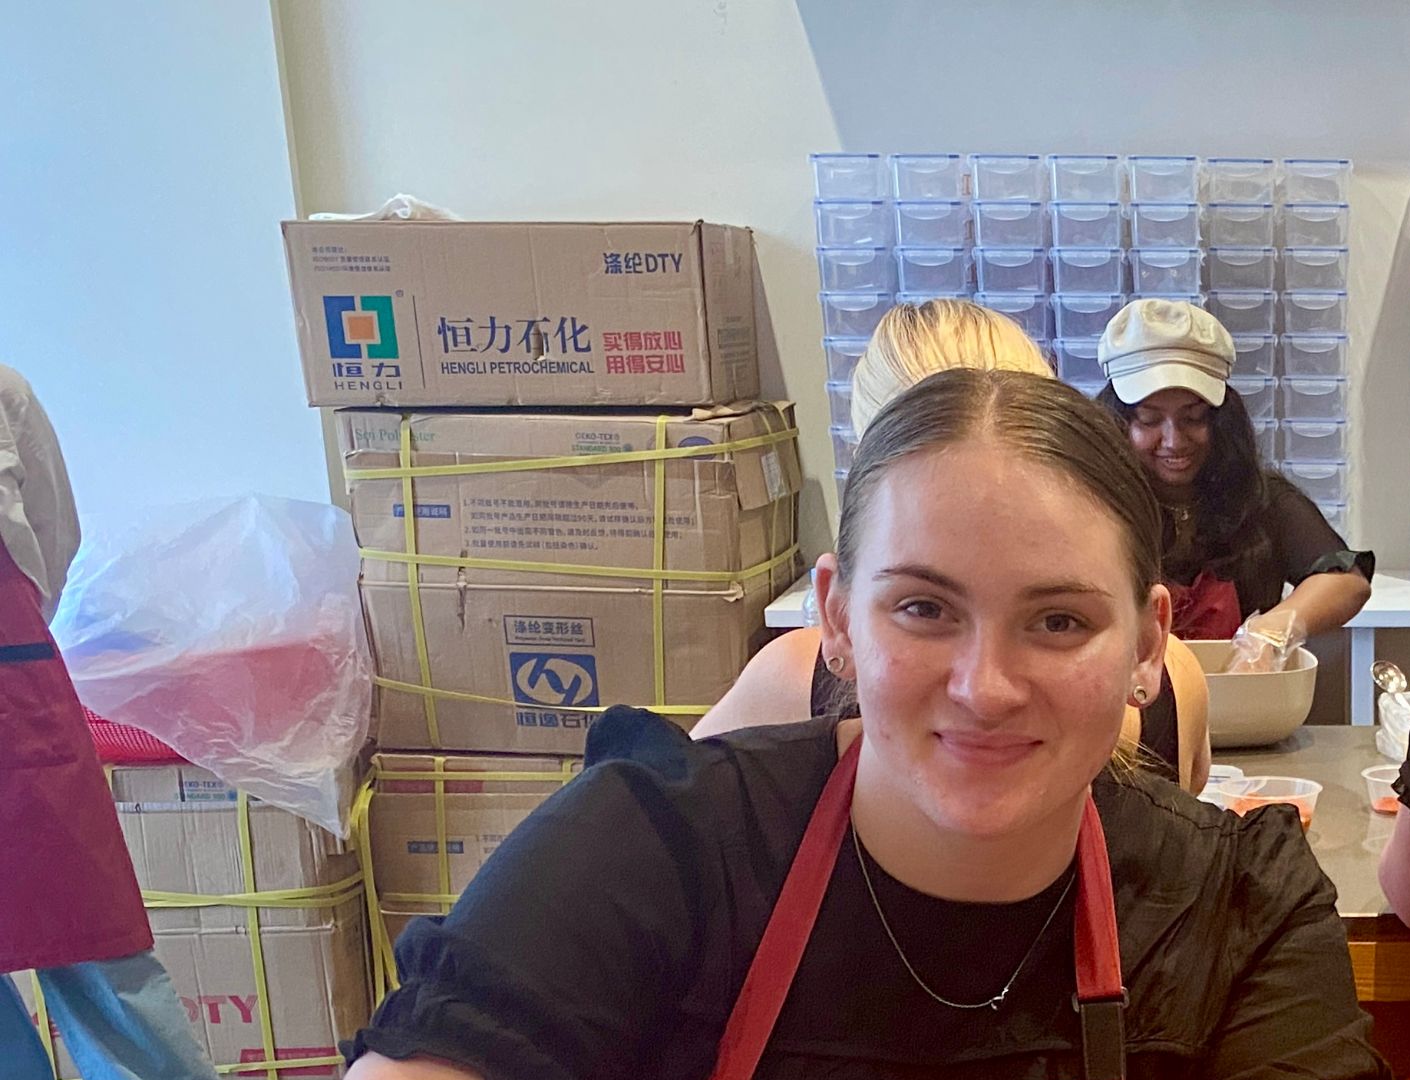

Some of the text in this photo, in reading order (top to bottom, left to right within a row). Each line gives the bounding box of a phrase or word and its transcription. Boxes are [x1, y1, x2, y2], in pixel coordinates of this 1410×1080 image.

[437, 315, 592, 354] 恒力石化
[602, 331, 684, 351] 买得放心
[332, 362, 401, 378] 恒力
[441, 361, 595, 374] HENGLI PETROCHEMICAL
[605, 354, 686, 374] 用得安心
[334, 381, 403, 390] HENGLI
